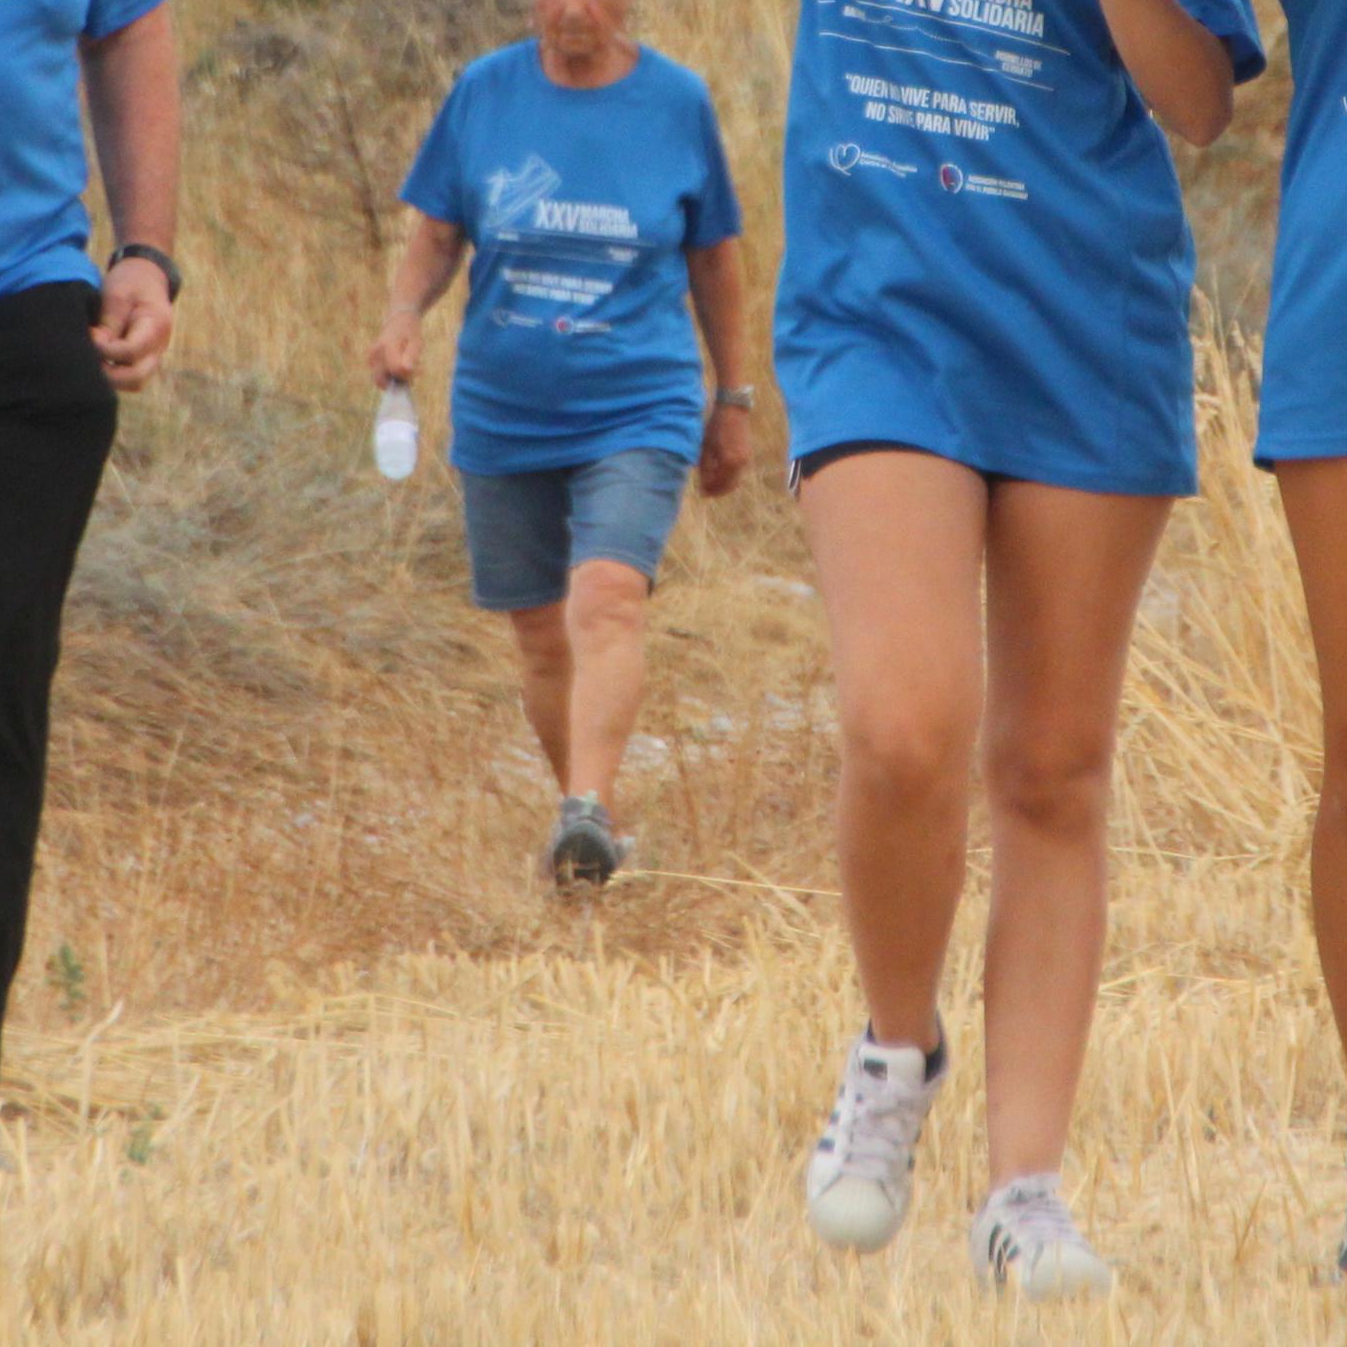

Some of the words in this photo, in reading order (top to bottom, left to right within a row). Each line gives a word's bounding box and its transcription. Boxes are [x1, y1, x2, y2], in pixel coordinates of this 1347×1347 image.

[901, 87, 931, 108] VIVE
[933, 91, 967, 115] PARA
[865, 102, 886, 122] NO
[915, 112, 951, 134] PARA
[534, 199, 580, 232] XXV
